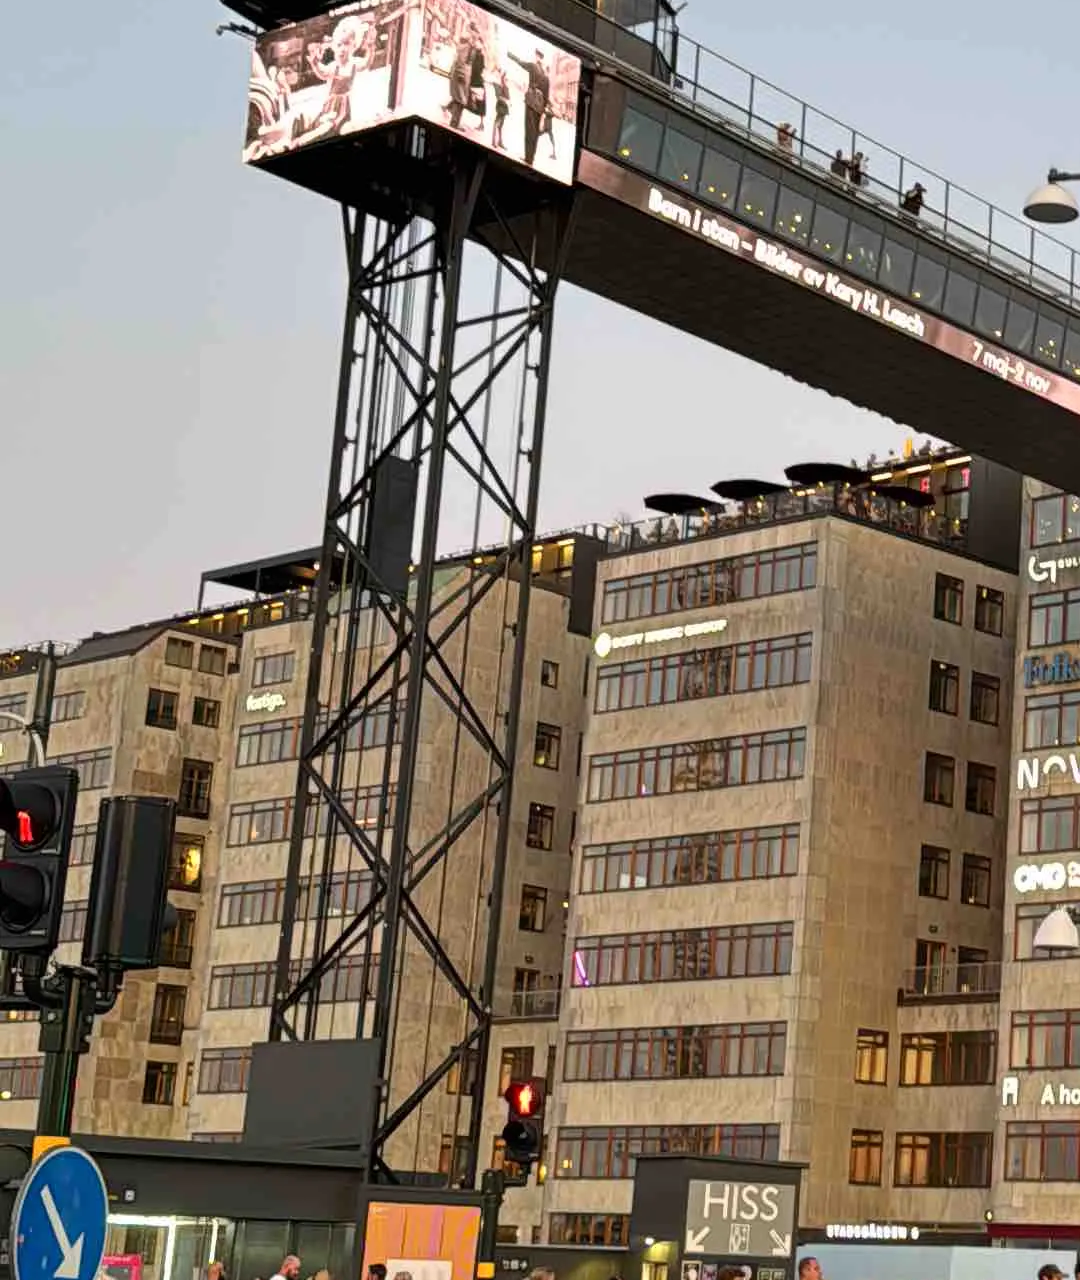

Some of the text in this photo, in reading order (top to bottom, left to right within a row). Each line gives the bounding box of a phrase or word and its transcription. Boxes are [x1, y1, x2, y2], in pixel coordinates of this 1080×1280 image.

[972, 339, 984, 362] 7
[1025, 370, 1052, 393] nov
[1040, 1083, 1055, 1105] A
[703, 1183, 779, 1222] HISS
